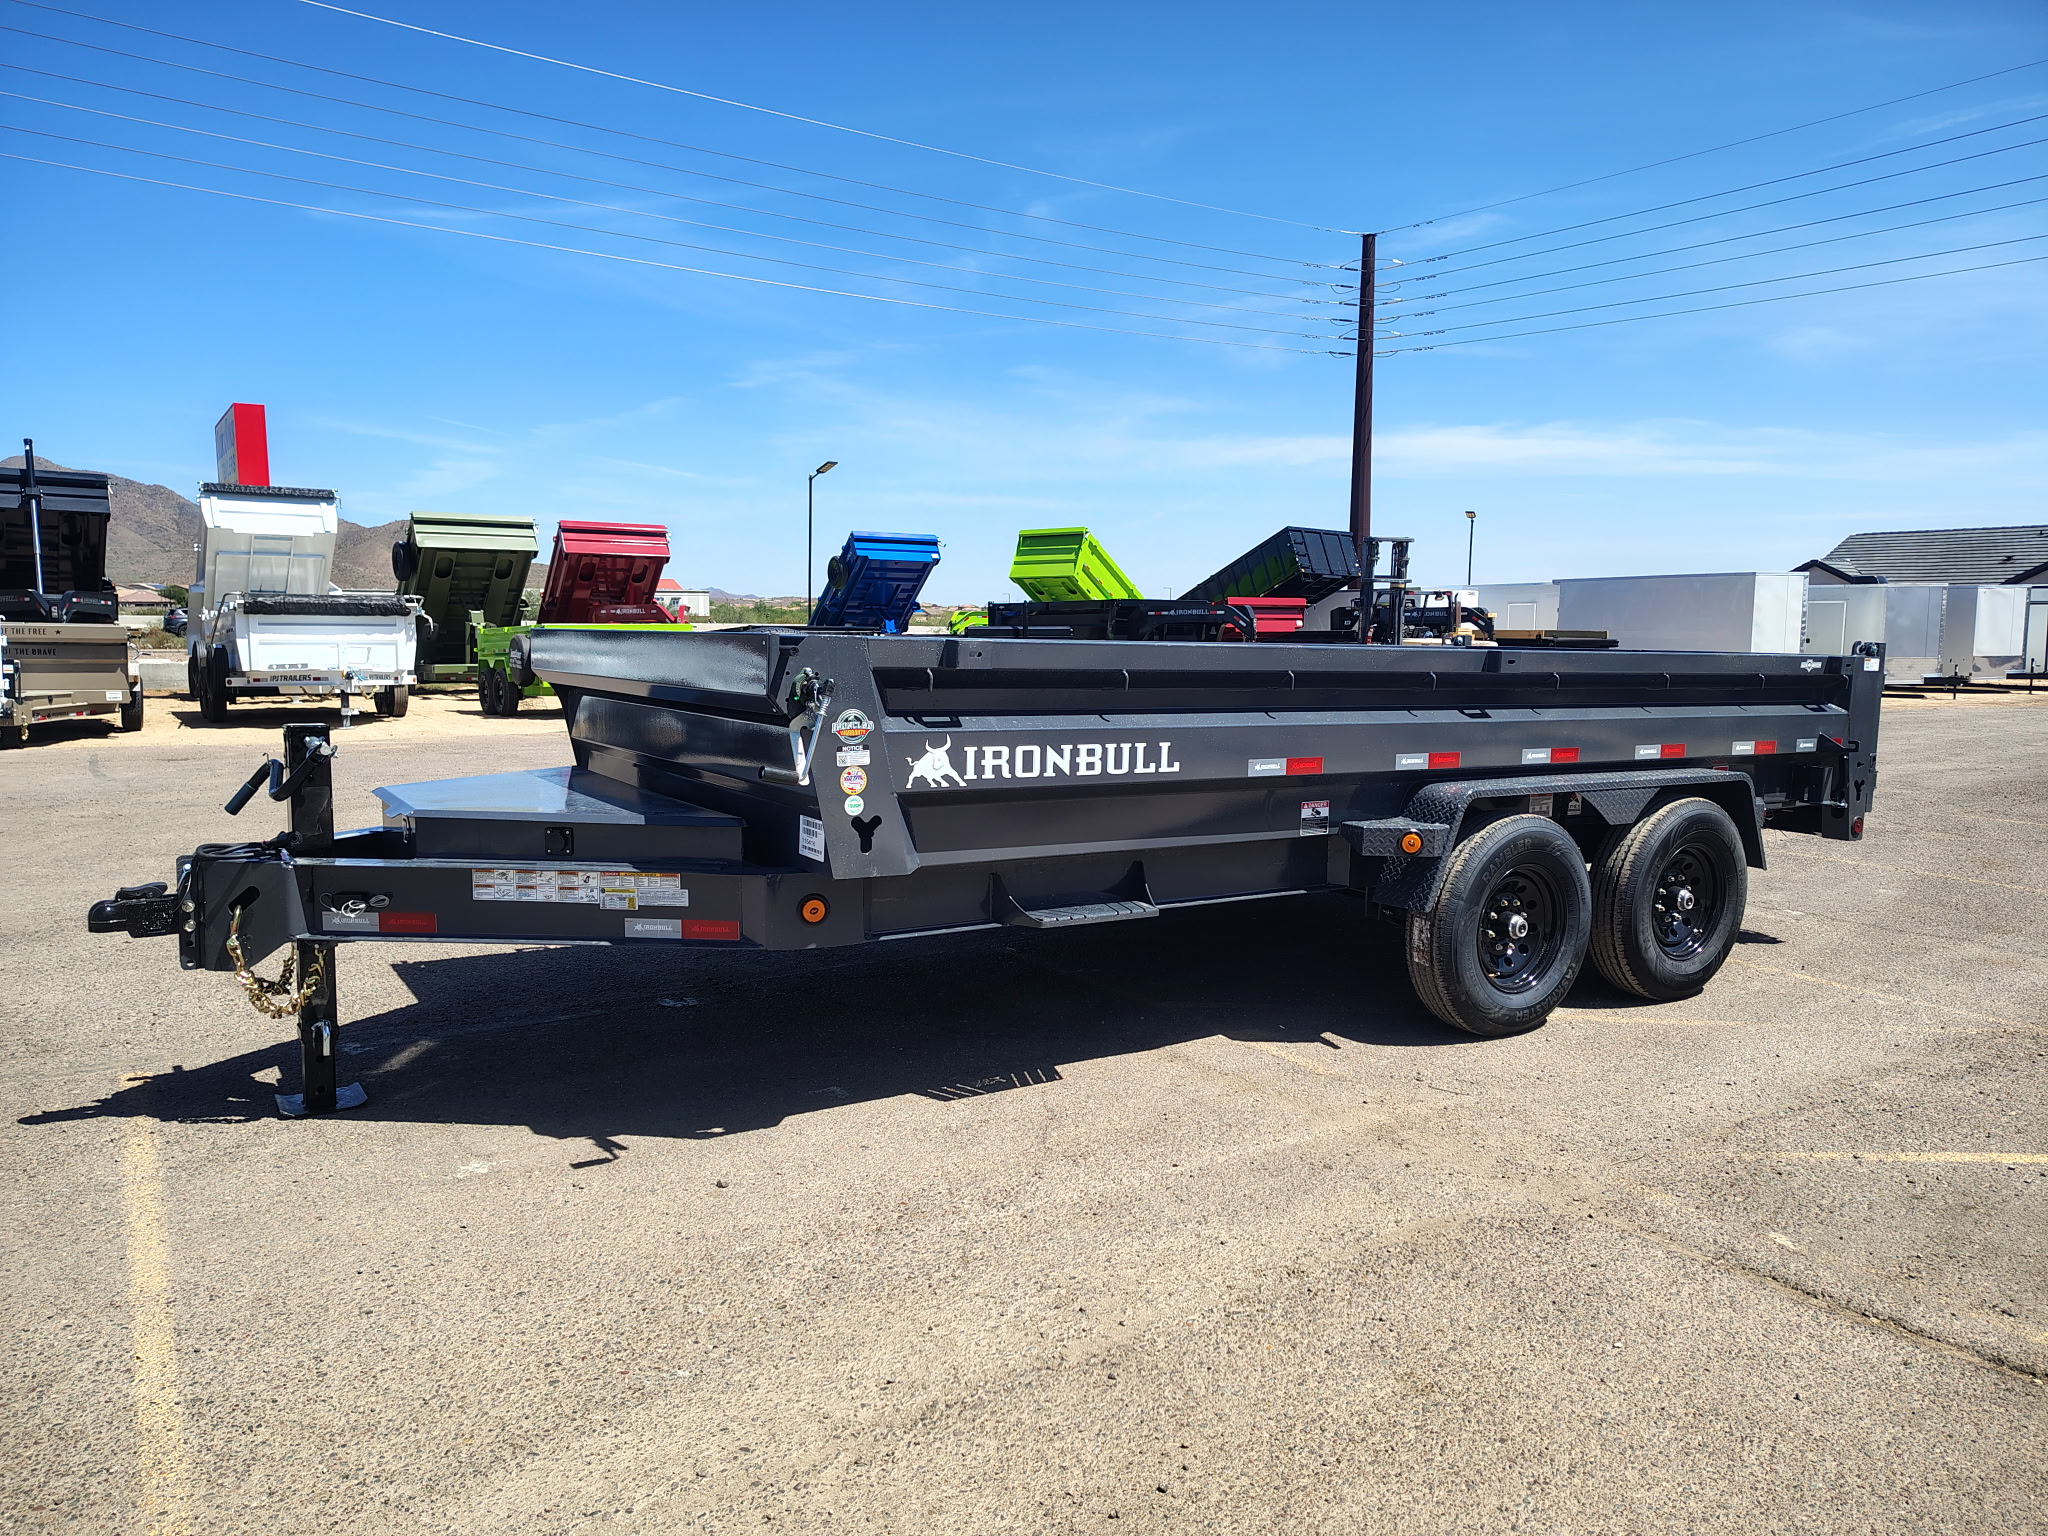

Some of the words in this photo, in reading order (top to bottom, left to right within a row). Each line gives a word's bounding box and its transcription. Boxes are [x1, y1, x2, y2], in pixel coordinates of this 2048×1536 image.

[32, 648, 57, 656] BRAVE
[963, 742, 1180, 780] IRONBULL
[1481, 838, 1533, 885] RAMBLER
[1515, 962, 1577, 1022] TASKMASTER
